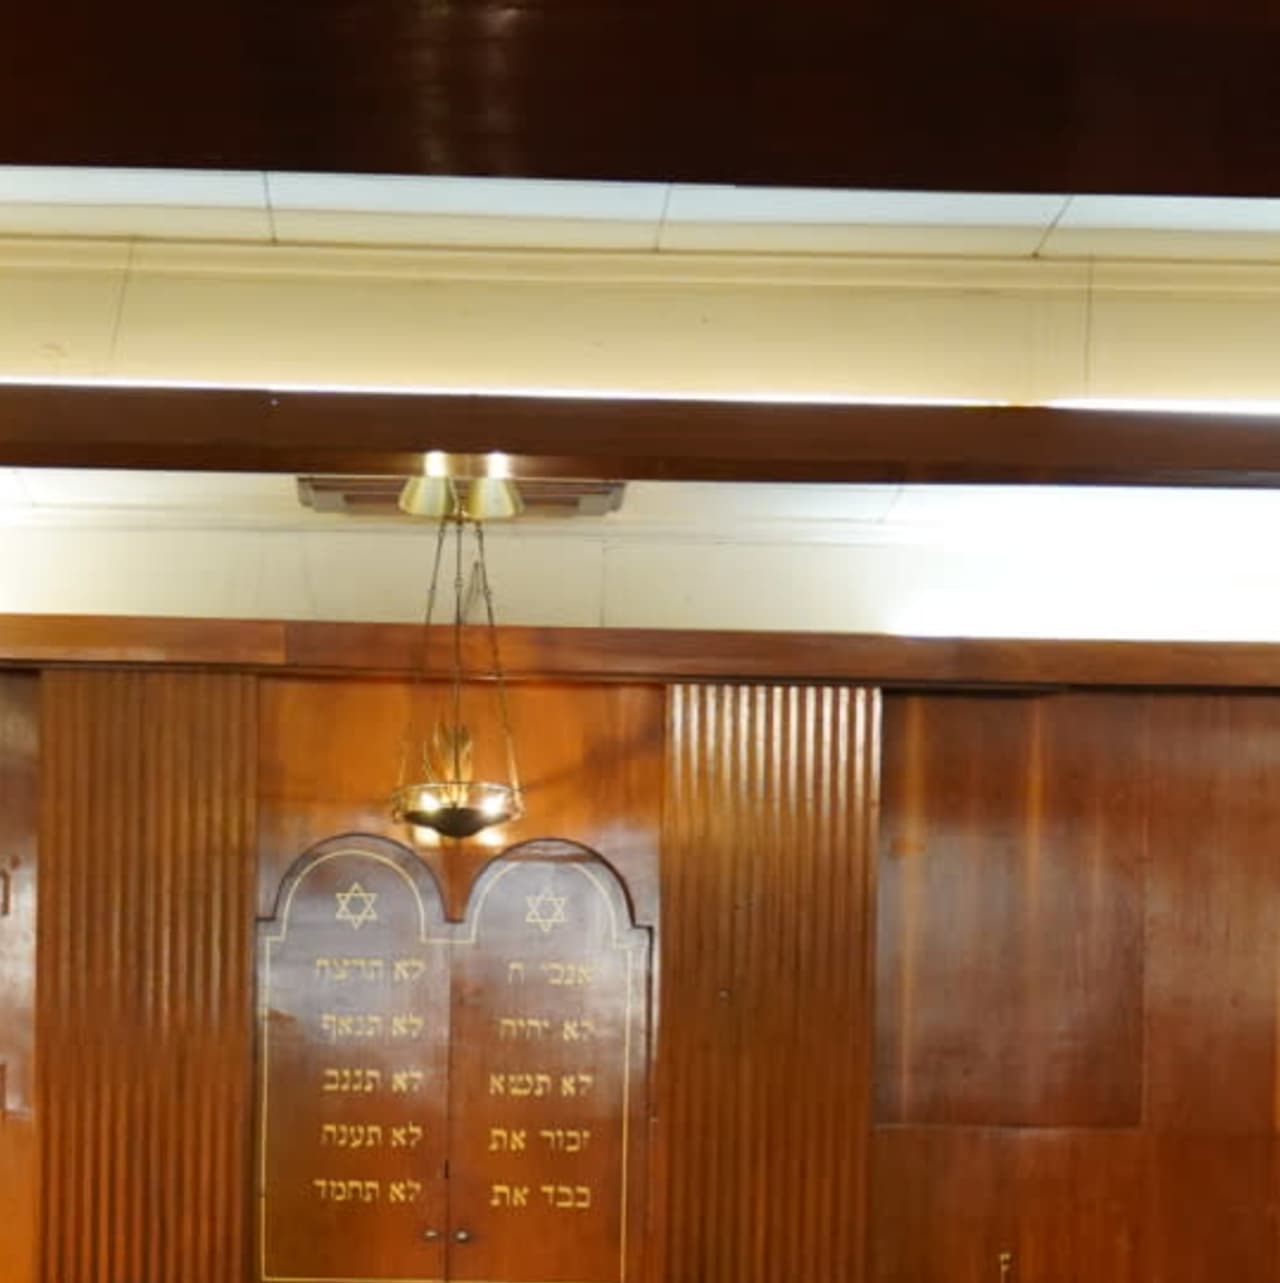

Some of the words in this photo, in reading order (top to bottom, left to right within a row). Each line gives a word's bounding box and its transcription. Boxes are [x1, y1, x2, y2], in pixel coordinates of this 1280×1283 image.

[393, 956, 426, 982] לא
[321, 1013, 382, 1044] תנאף
[391, 1011, 424, 1037] לא
[499, 1017, 551, 1041] יהיה
[561, 1015, 594, 1042] לא
[391, 1066, 424, 1093] לא
[489, 1073, 552, 1097] תשא
[560, 1071, 593, 1096] לא
[320, 1123, 383, 1149] תענה
[391, 1120, 423, 1148] לא
[489, 1128, 528, 1153] את
[540, 1128, 591, 1153] זכור
[312, 1179, 380, 1203] תחמד
[389, 1177, 422, 1203] לא
[490, 1184, 531, 1209] את
[540, 1184, 592, 1210] כבד
